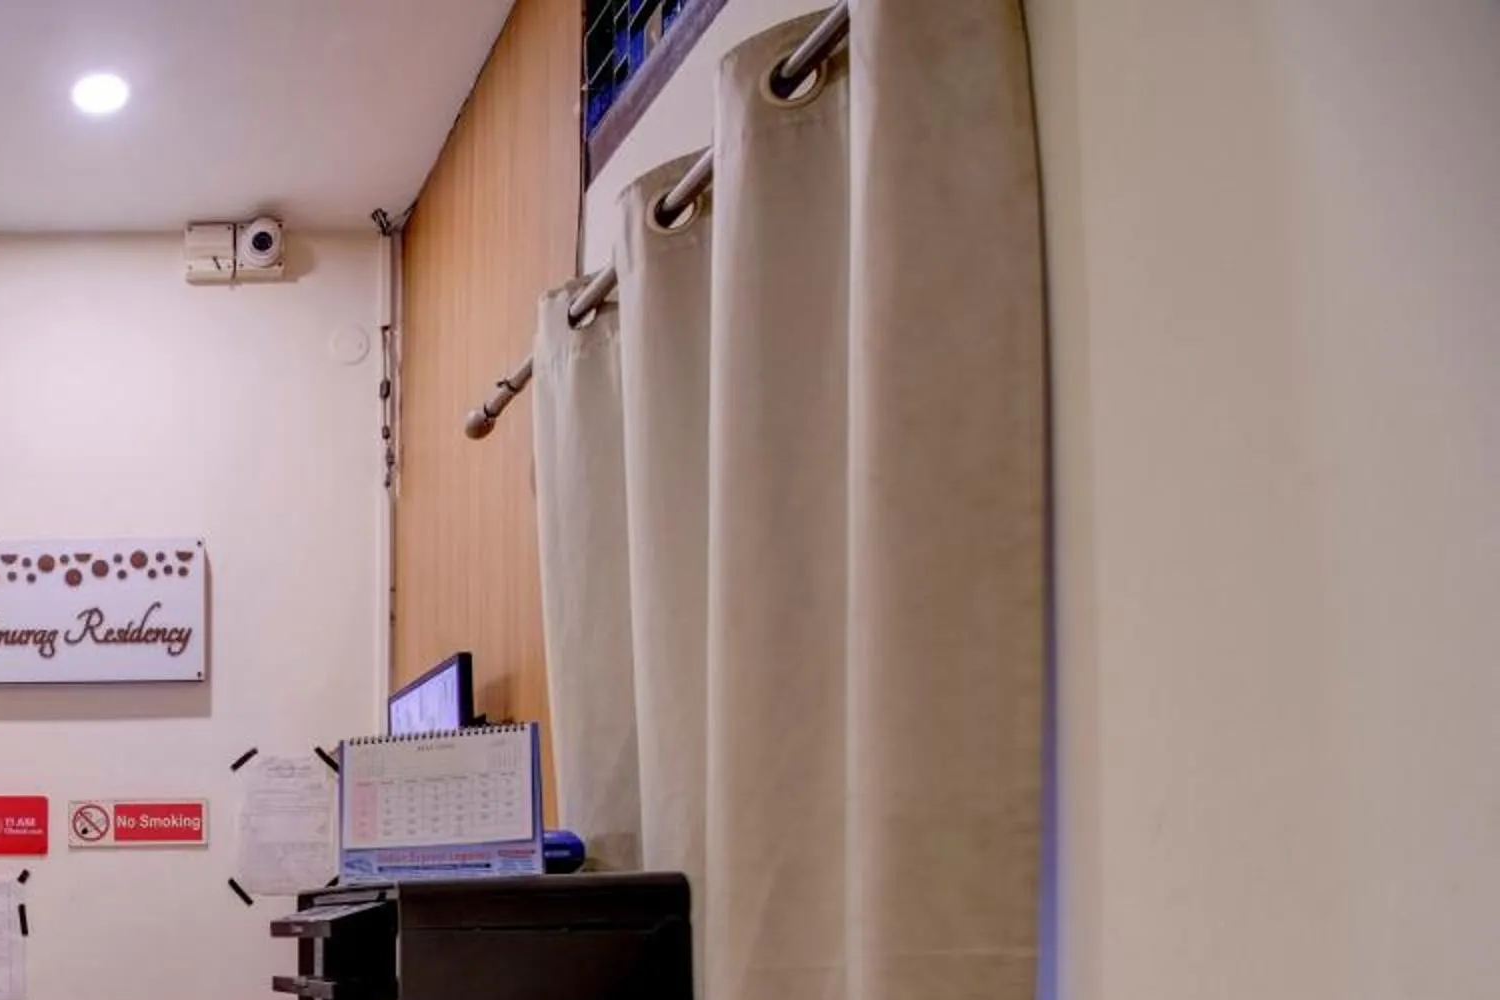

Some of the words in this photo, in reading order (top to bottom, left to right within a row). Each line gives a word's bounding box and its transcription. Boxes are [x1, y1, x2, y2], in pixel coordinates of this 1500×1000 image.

[63, 601, 193, 657] Residency
[117, 815, 135, 829] No
[139, 814, 200, 831] Smoking
